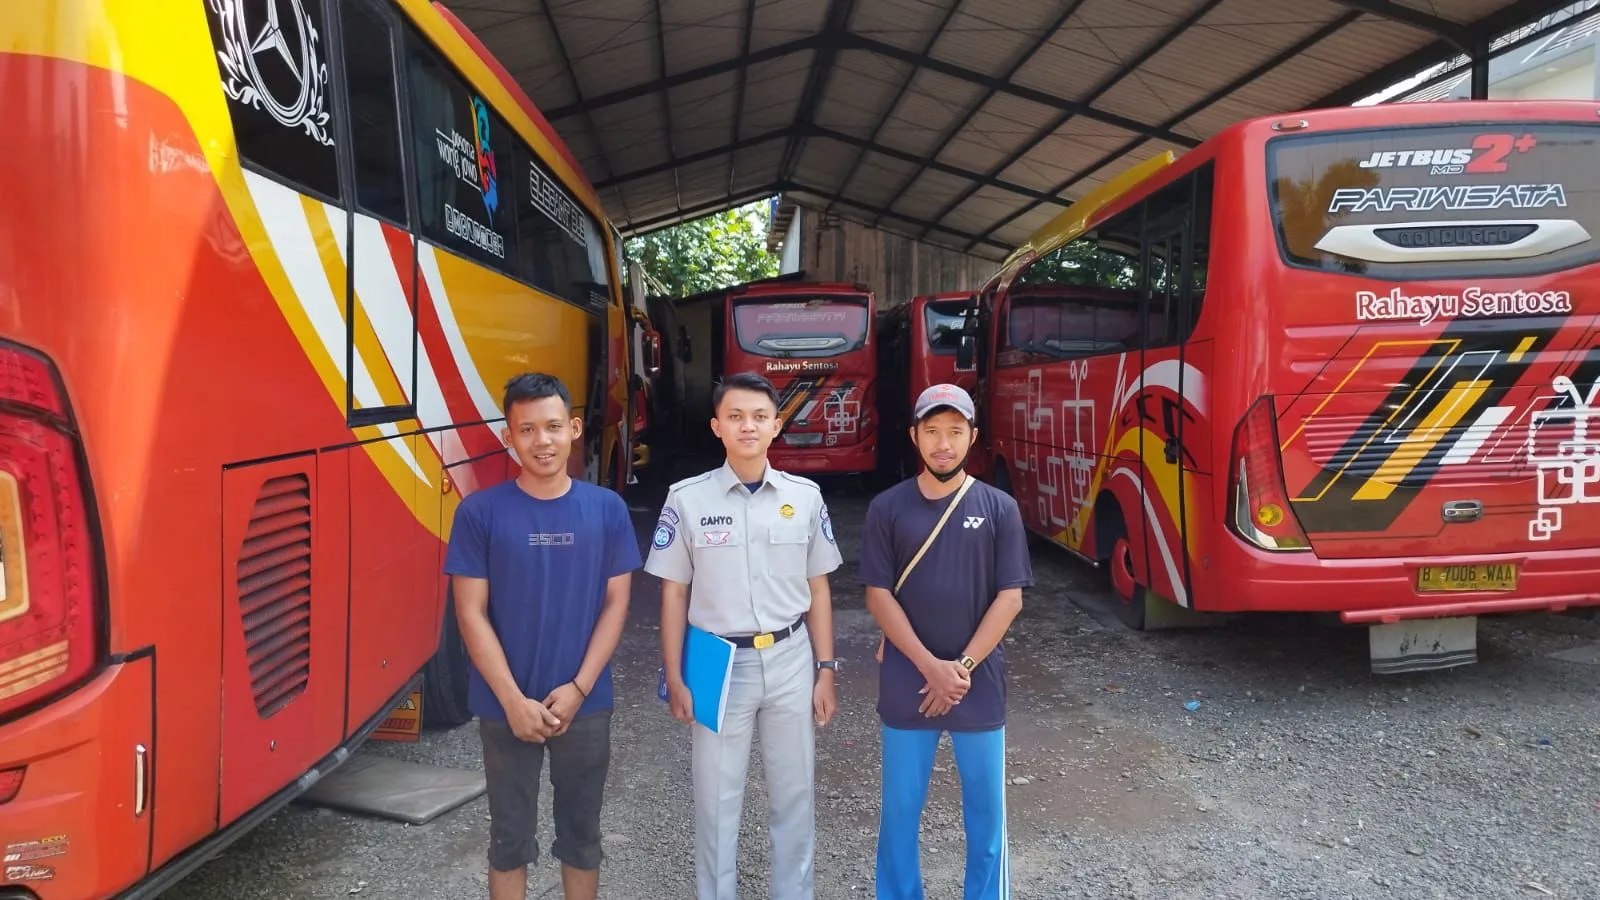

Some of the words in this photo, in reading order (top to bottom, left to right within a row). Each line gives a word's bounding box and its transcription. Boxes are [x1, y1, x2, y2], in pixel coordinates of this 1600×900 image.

[436, 137, 461, 179] wong
[1360, 149, 1473, 168] JETBUS
[1465, 133, 1537, 174] 2+
[1430, 165, 1464, 176] MD
[1329, 183, 1567, 212] PARIWISATA
[1400, 228, 1511, 246] adiputro
[1356, 287, 1459, 326] Rahayu
[1462, 287, 1572, 317] Sentosa
[766, 361, 801, 373] Rahayu
[802, 361, 839, 370] Sentosa
[700, 516, 733, 527] CAHYO
[1423, 567, 1431, 581] B
[1443, 565, 1476, 581] 7006
[1487, 564, 1512, 580] WAA
